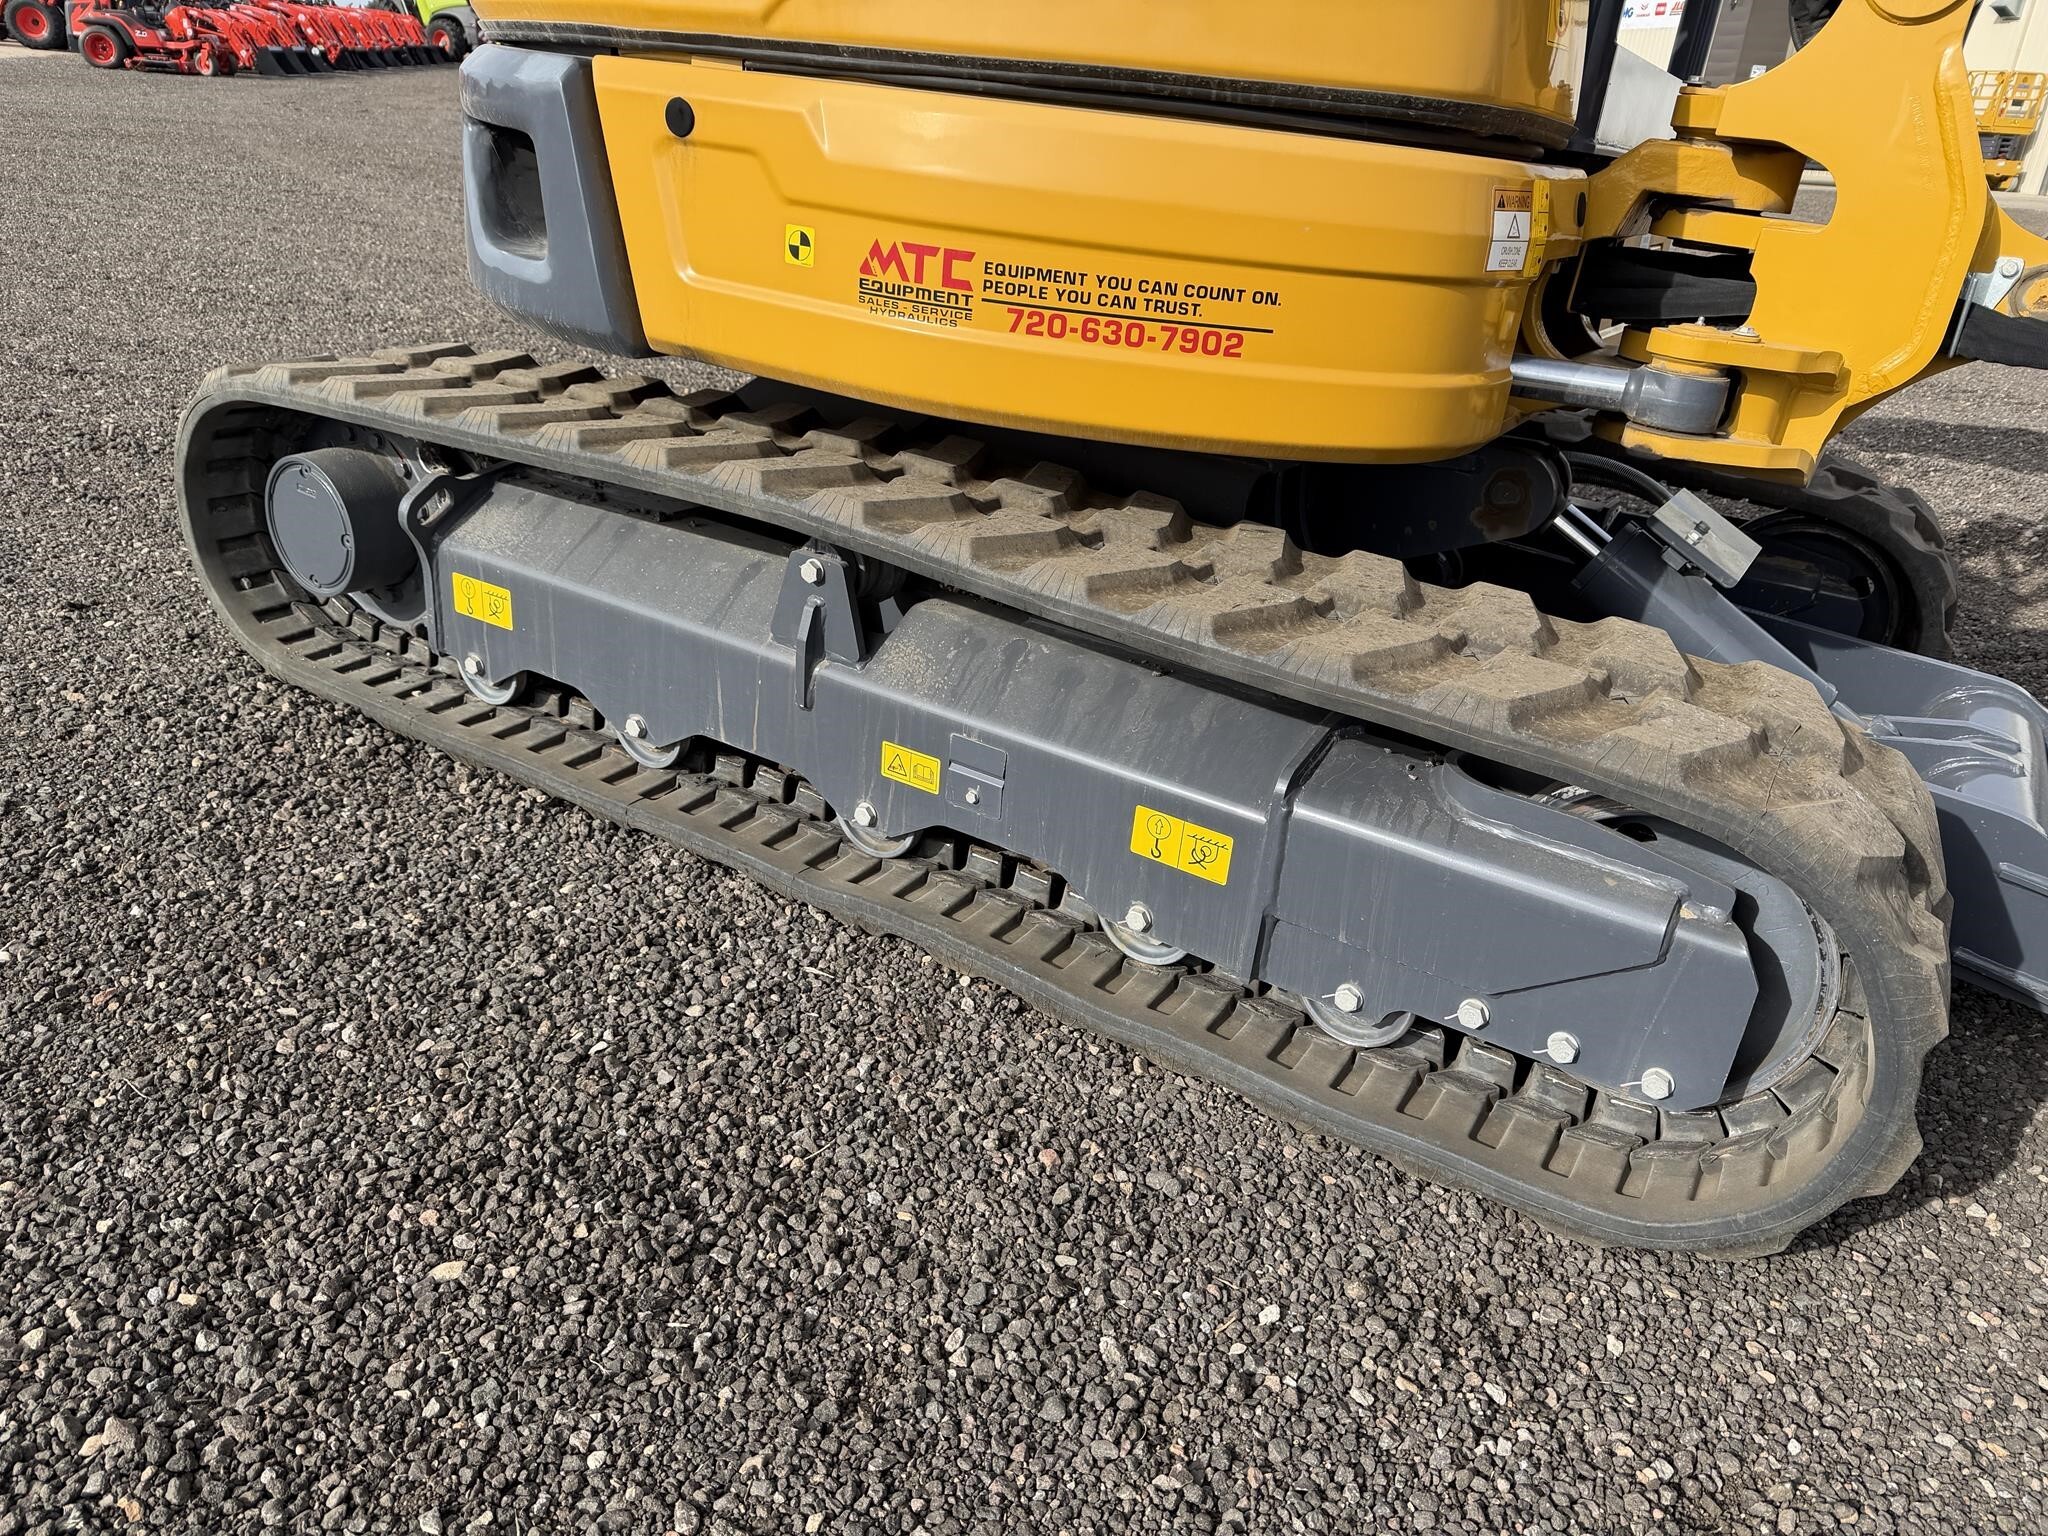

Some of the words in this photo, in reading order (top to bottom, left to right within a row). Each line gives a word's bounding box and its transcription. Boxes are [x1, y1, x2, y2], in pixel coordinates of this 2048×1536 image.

[1506, 194, 1530, 209] WARNING
[859, 238, 977, 292] MTC
[859, 277, 975, 307] EQUIPMENT
[983, 279, 1049, 300] PEOPLE
[1055, 288, 1092, 305] YOU
[1097, 293, 1137, 311] CAN
[1143, 298, 1203, 318] TRUST.
[984, 261, 1089, 287] EQUIPMENT
[1096, 274, 1133, 292] YOU
[1138, 279, 1179, 297] CAN
[1184, 284, 1247, 303] COUNT
[1252, 290, 1282, 307] ON.
[858, 295, 899, 310] SALES
[911, 304, 973, 321] SERVICE
[870, 306, 958, 328] HYDRAULICS
[1006, 307, 1245, 359] 720-630-7902
